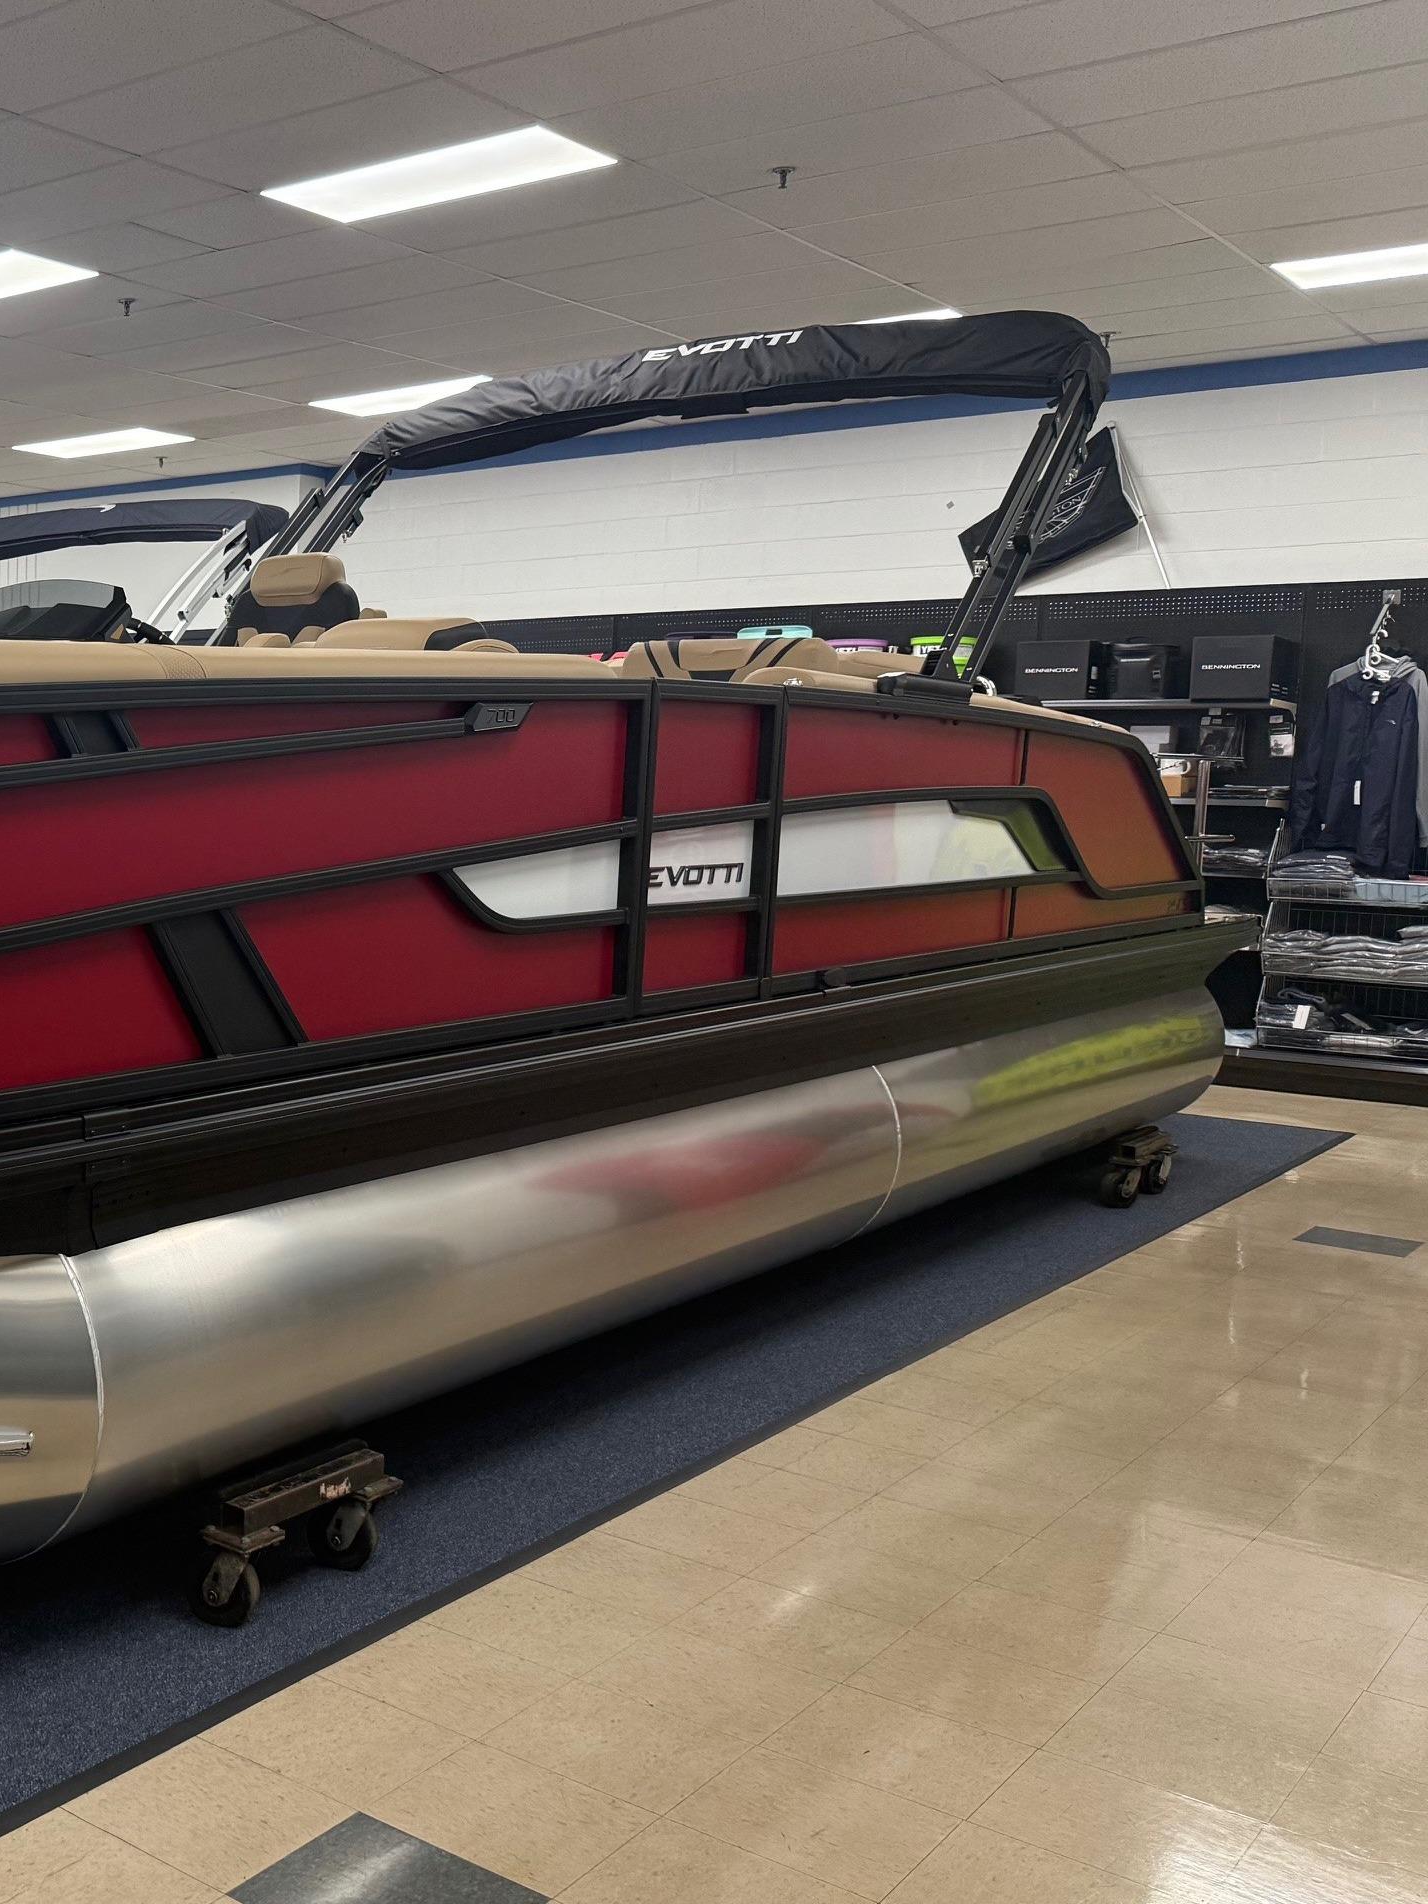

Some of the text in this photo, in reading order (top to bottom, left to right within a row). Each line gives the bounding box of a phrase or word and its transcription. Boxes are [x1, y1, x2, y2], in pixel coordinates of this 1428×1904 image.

[641, 330, 804, 362] EVOTTI
[486, 708, 515, 723] 700
[648, 862, 744, 888] EVOTTI
